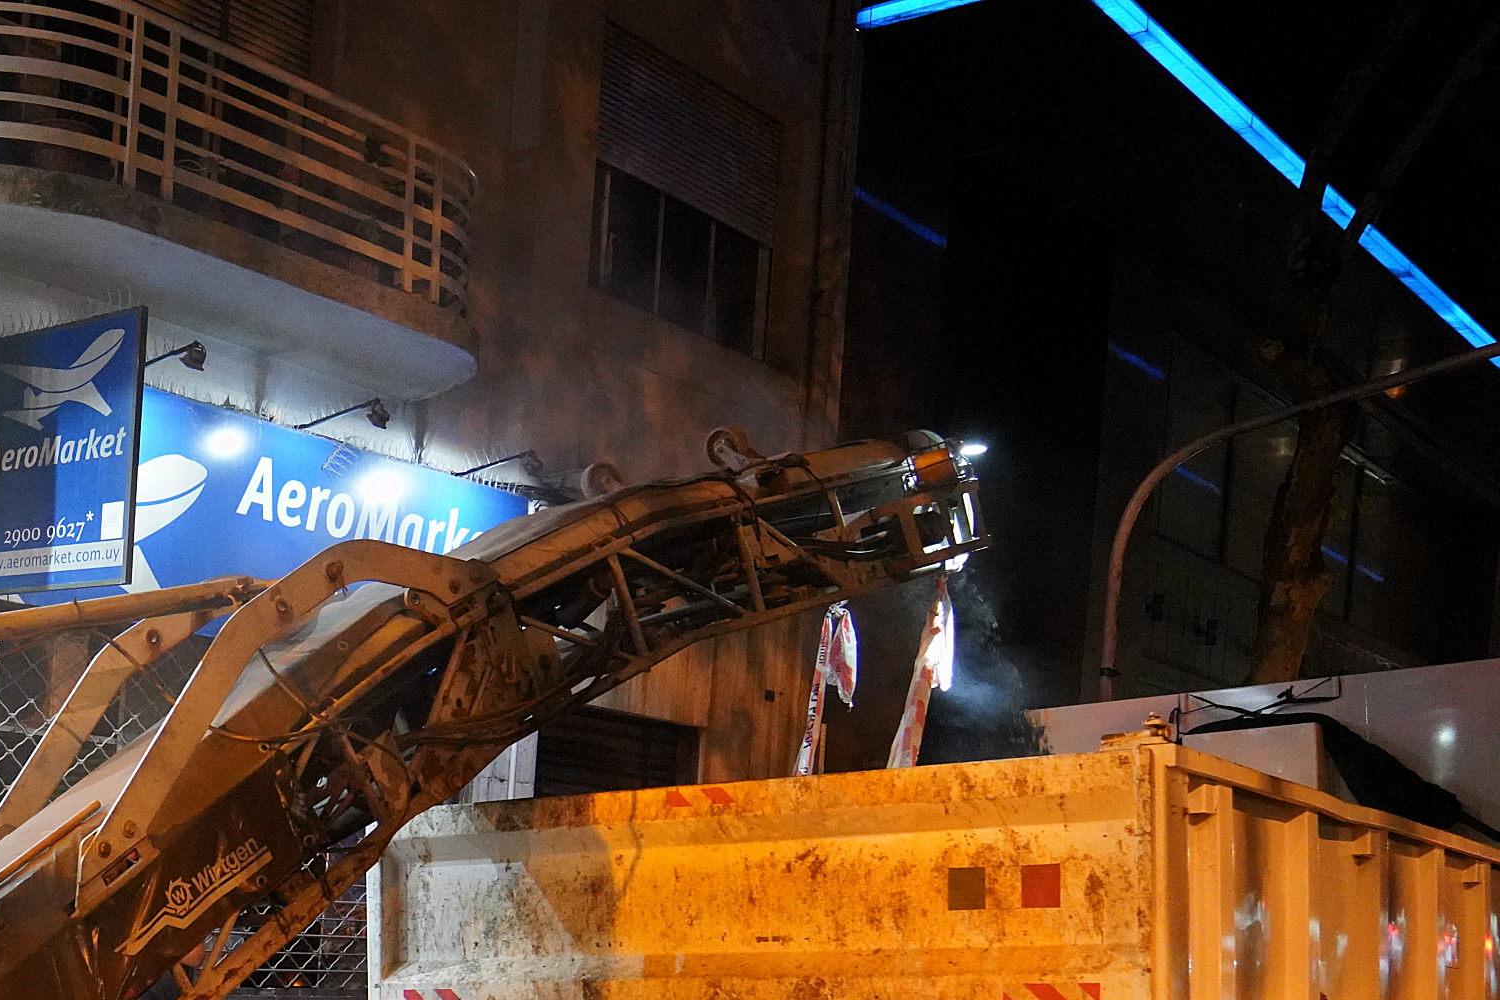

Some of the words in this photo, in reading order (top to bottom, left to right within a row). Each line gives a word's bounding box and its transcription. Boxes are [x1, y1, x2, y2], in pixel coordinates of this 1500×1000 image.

[236, 456, 484, 555] AeroMark
[3, 528, 41, 548] 2900
[192, 838, 260, 893] Wirtgen
